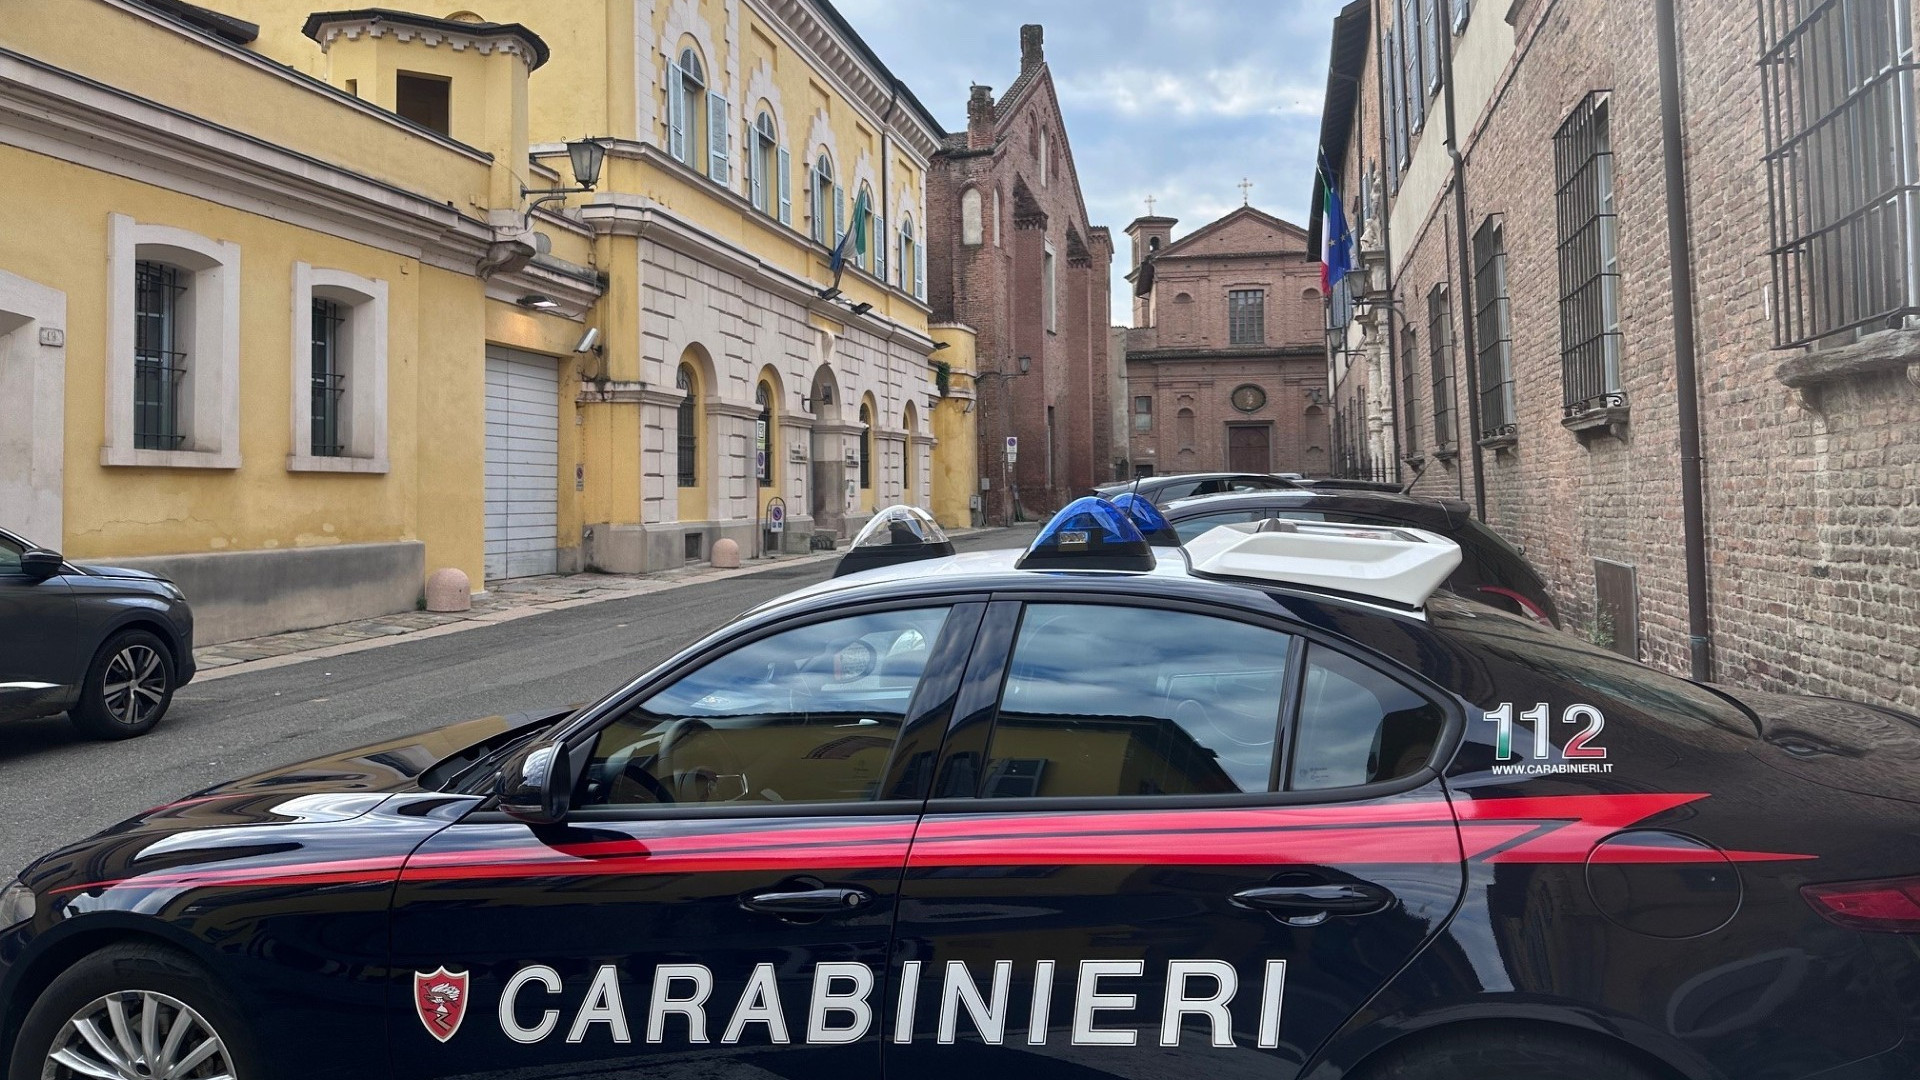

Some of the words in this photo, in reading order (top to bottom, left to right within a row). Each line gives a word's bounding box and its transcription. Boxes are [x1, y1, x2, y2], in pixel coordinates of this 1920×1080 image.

[1483, 702, 1607, 760] 112
[1492, 763, 1614, 775] WWW.CARABINIERI.IT
[498, 959, 1287, 1048] CARABINIERI
